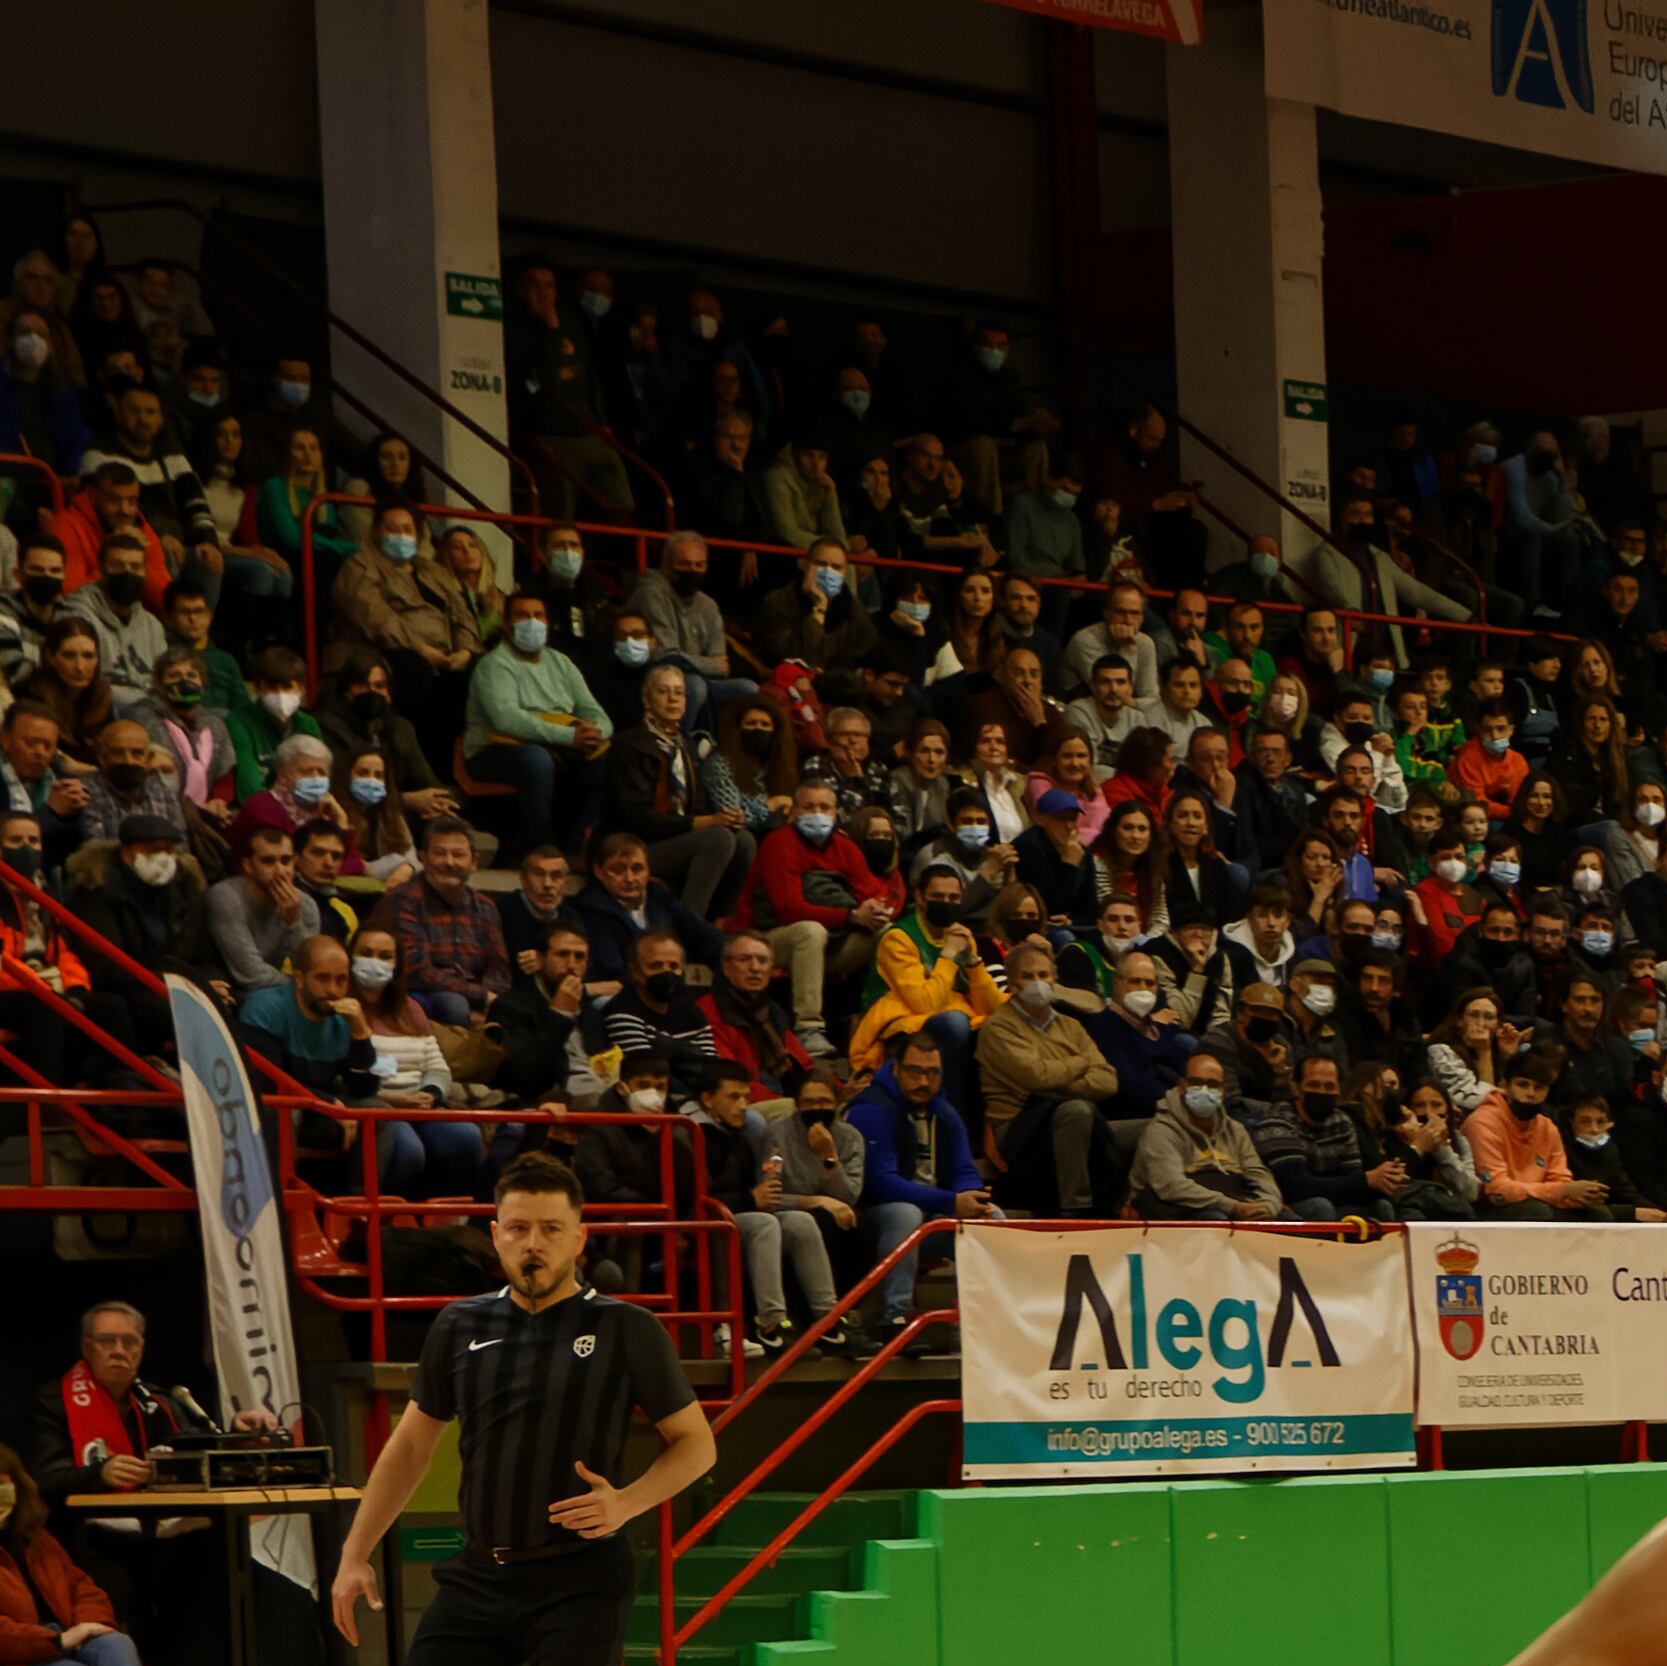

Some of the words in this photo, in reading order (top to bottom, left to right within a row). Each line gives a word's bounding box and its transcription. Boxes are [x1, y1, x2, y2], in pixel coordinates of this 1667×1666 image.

[1609, 90, 1640, 125] del
[1488, 1275, 1589, 1296] GOBIERNO
[1050, 1253, 1341, 1404] AlegA
[1489, 1306, 1509, 1326] de
[1491, 1335, 1601, 1357] CANTABRIA
[1049, 1382, 1071, 1401] es
[1087, 1379, 1108, 1400] tu
[1126, 1374, 1202, 1399] derecho
[1047, 1424, 1228, 1456] info@grupoalega.es
[1310, 1421, 1345, 1444] 672
